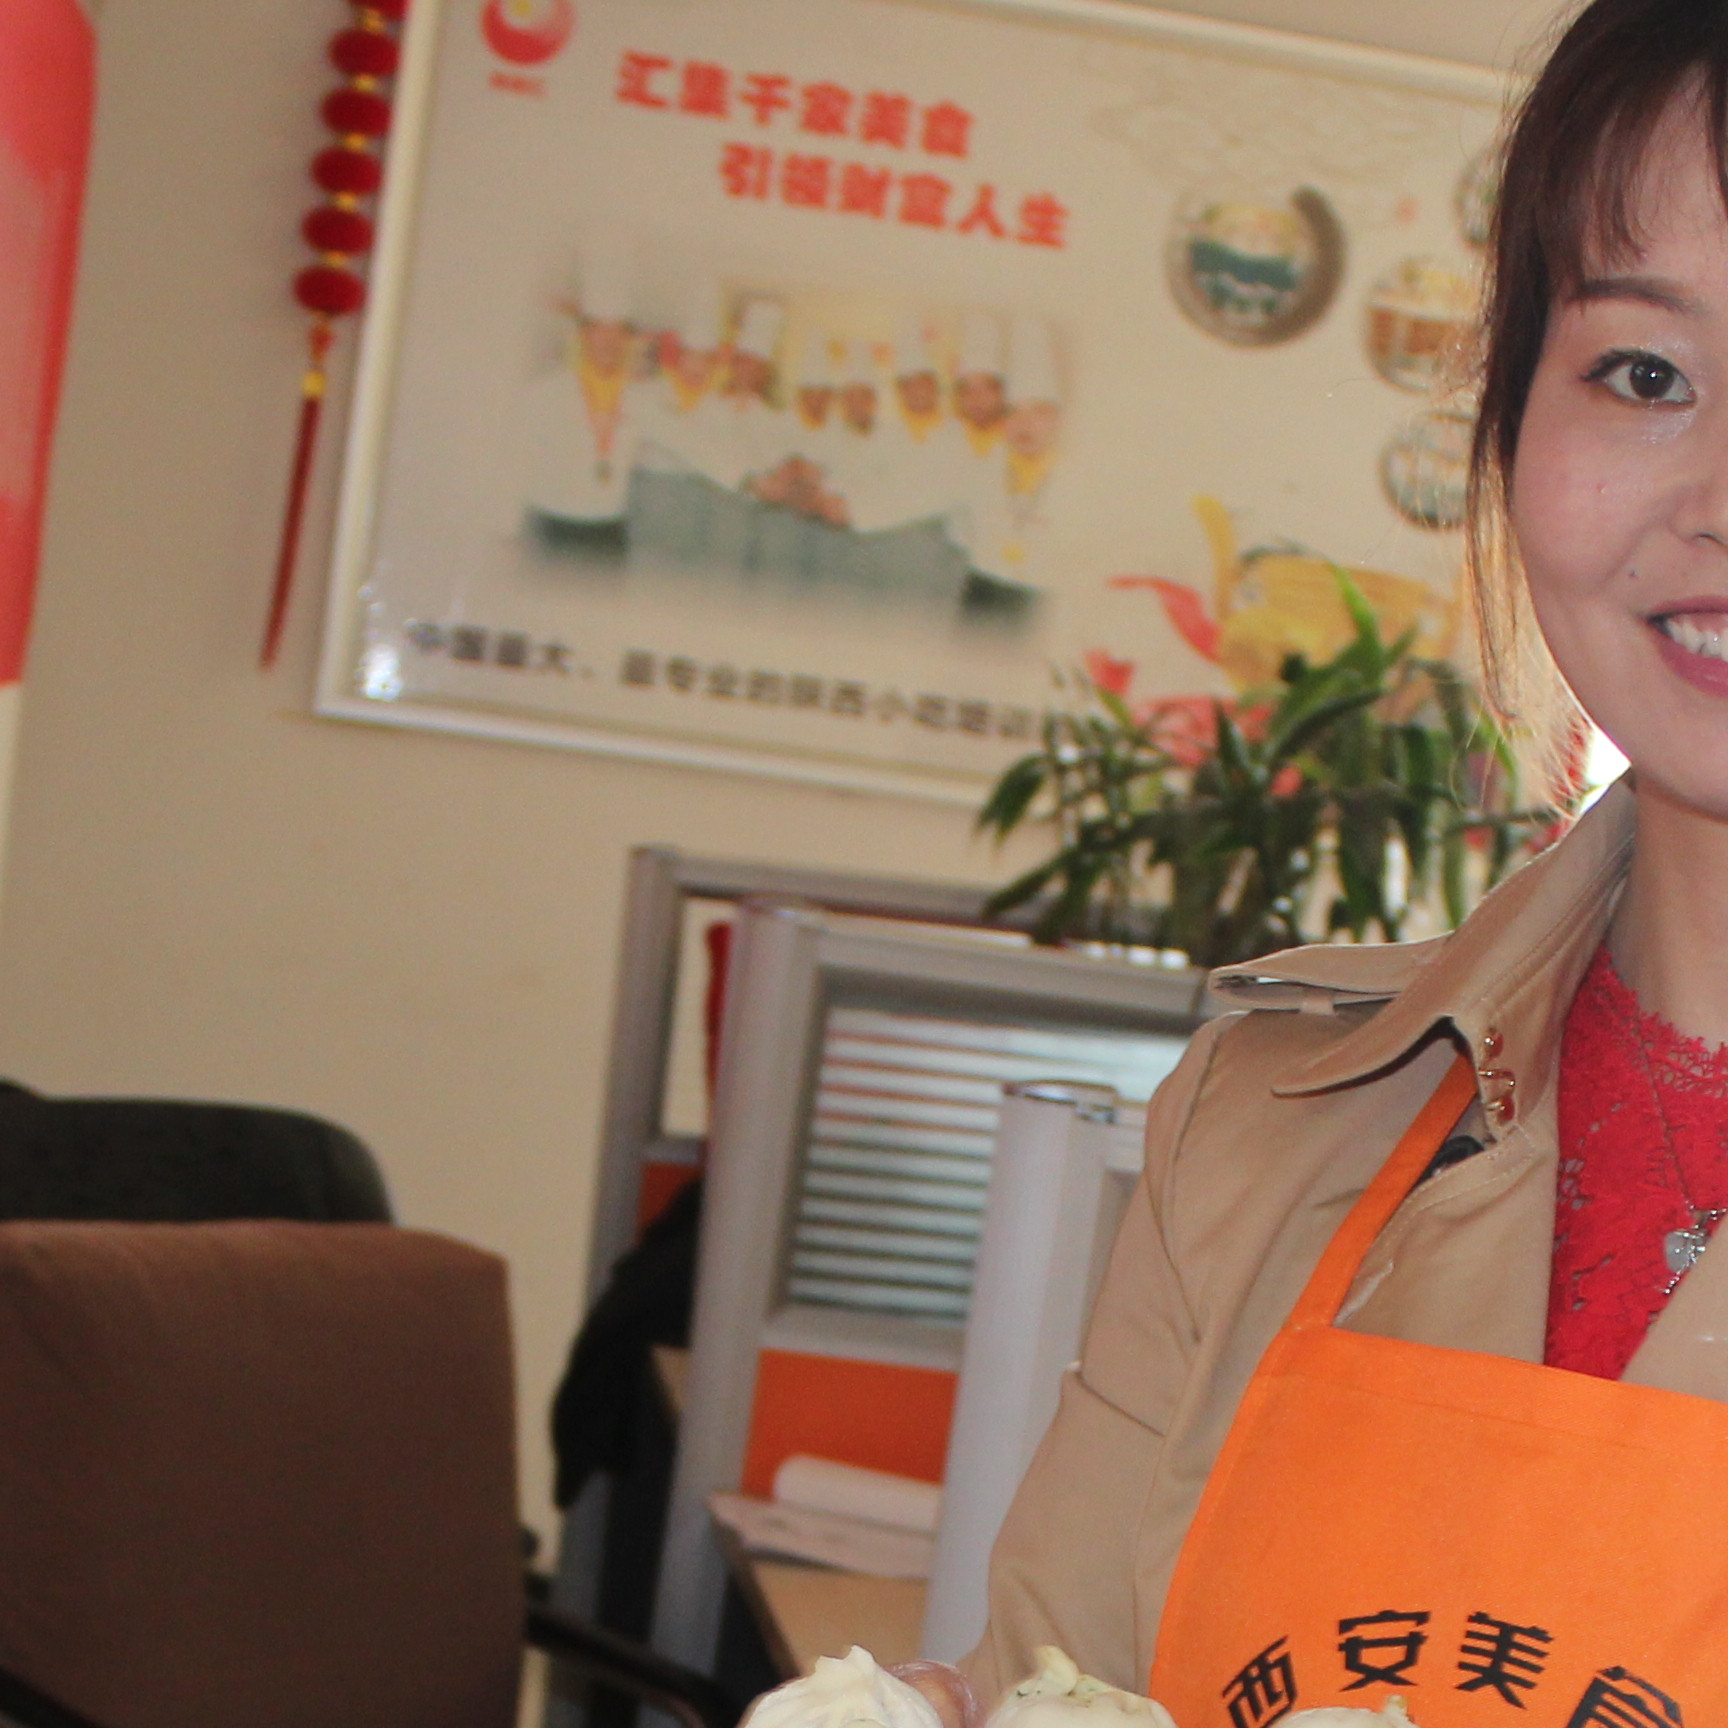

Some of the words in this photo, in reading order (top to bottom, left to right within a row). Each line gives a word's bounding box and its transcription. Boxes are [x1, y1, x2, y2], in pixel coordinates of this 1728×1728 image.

[406, 620, 1069, 750] 中国最大、最专业的陕西小吃培训
